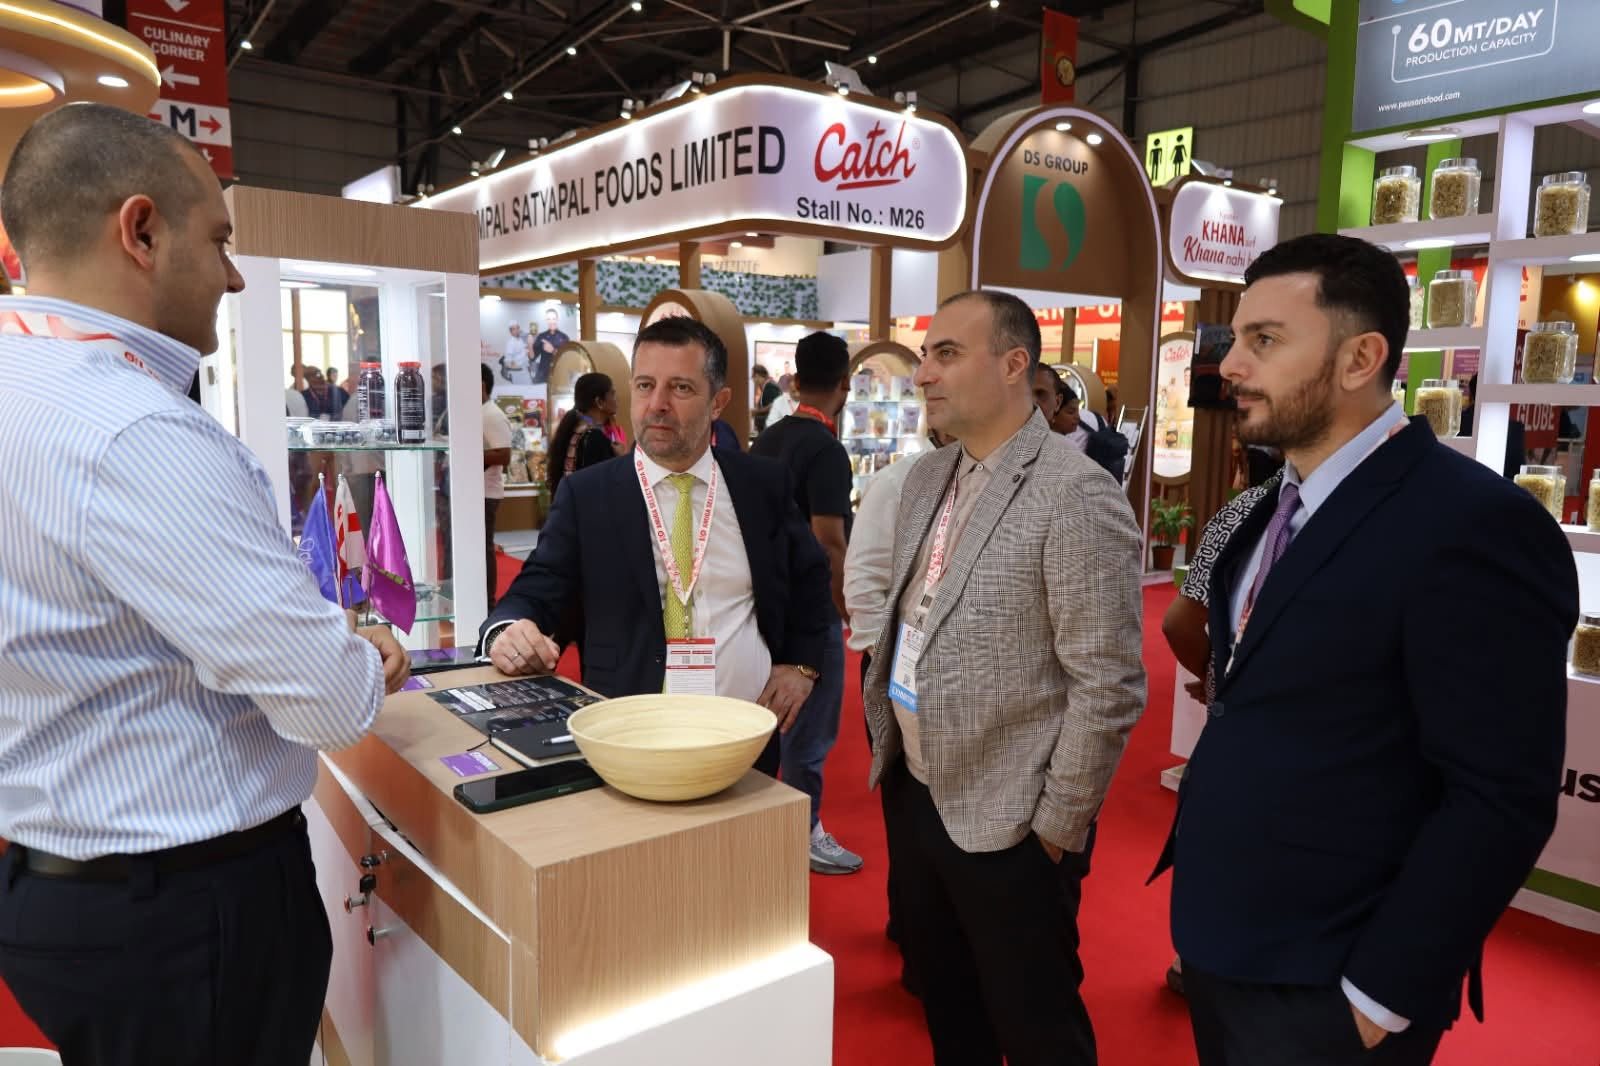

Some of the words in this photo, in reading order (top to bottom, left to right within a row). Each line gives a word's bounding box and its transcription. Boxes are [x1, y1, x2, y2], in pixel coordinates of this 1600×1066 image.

[143, 26, 210, 48] CULINARY
[151, 42, 205, 62] CORNER
[1406, 45, 1478, 67] PRODUCTION
[1480, 31, 1537, 53] CAPACITY
[170, 104, 196, 137] M
[814, 119, 917, 184] Catch
[1024, 150, 1040, 167] DS
[1044, 154, 1089, 175] GROUP
[512, 177, 590, 231] SATYAPAL
[595, 151, 663, 211] FOODS
[671, 125, 786, 192] LIMITED
[797, 196, 840, 221] Stall
[847, 202, 884, 225] No.:
[890, 207, 925, 230] M26
[1202, 219, 1245, 247] KHANA
[1183, 235, 1225, 264] Khana
